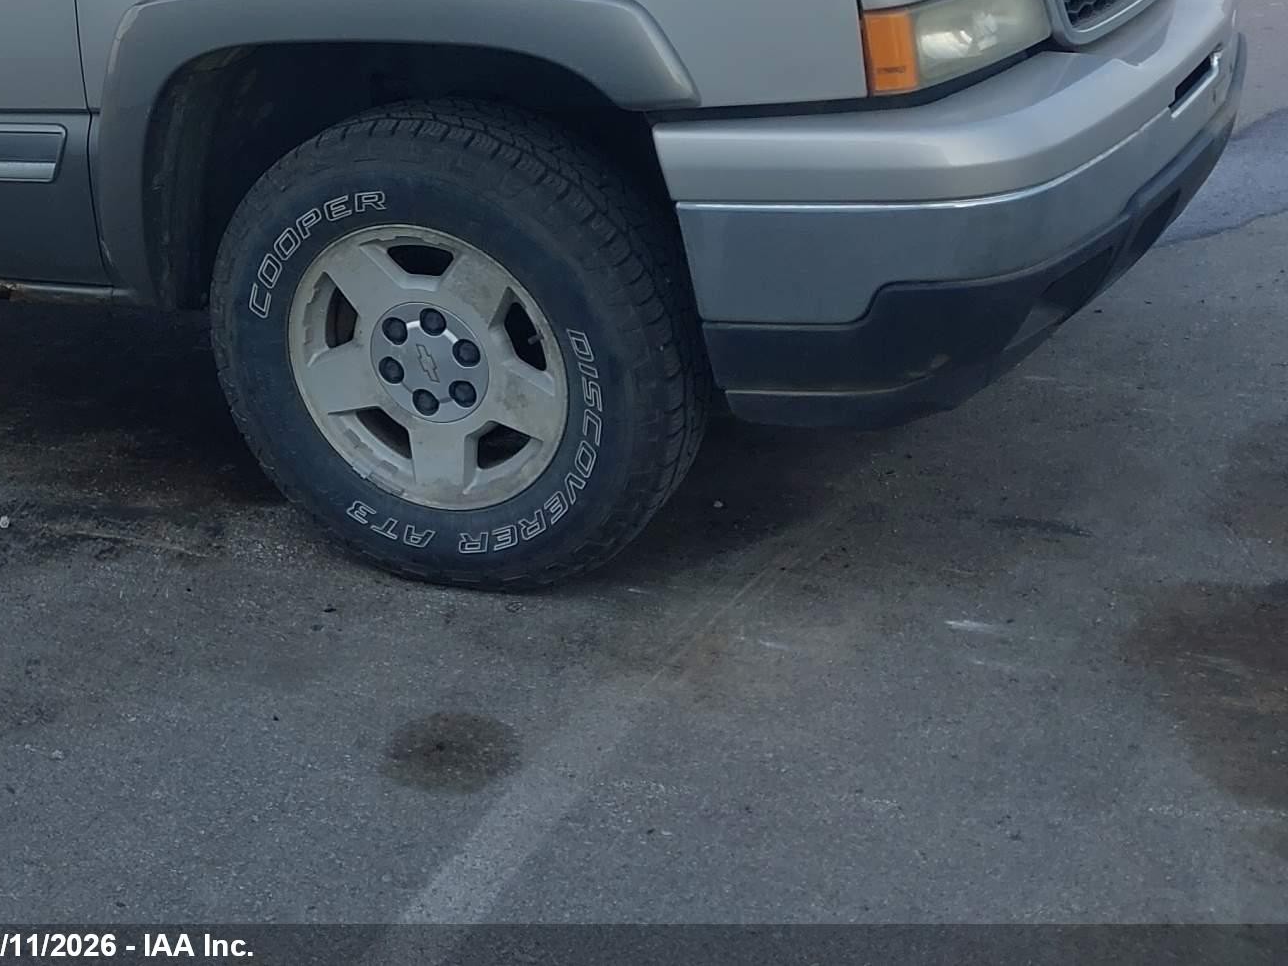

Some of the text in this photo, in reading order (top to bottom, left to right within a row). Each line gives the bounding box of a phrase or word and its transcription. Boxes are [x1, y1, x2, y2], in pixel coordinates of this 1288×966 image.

[248, 190, 387, 319] COOPER
[346, 328, 603, 554] DISCOVERER AT3
